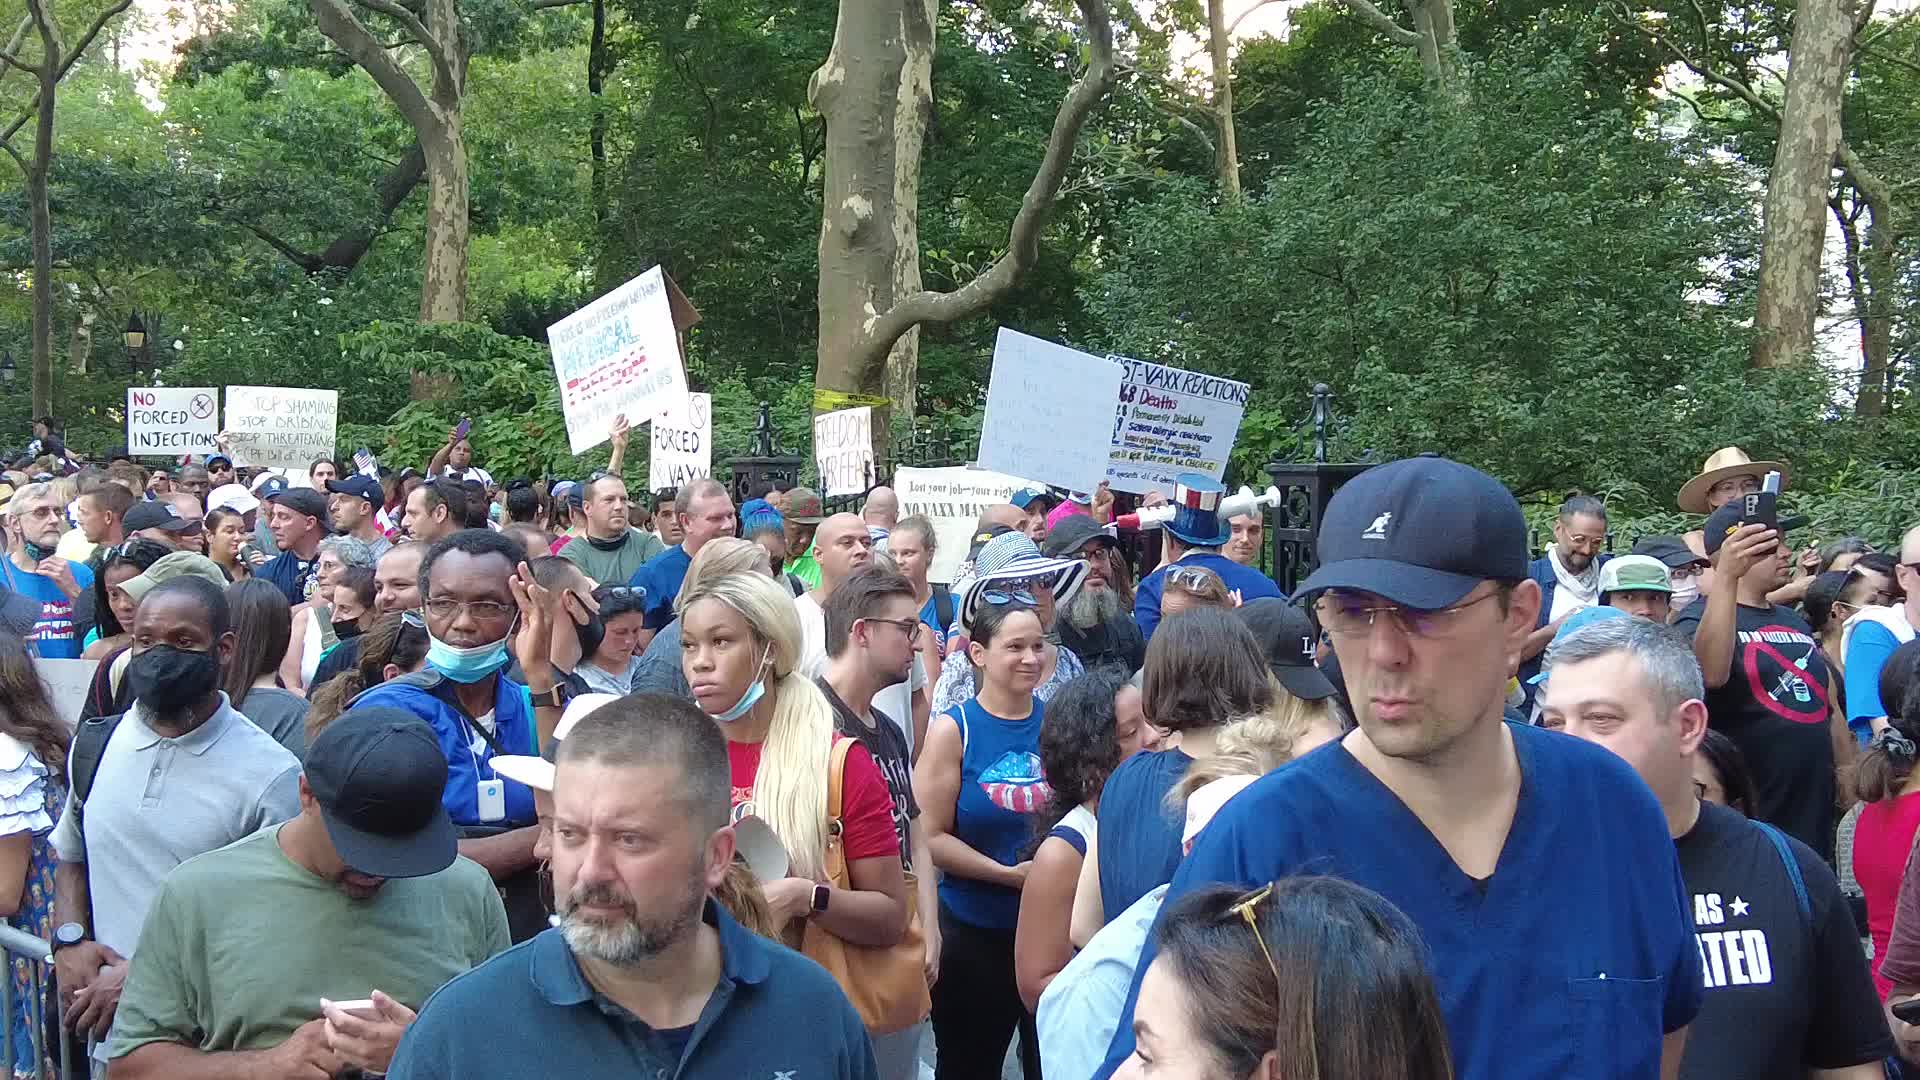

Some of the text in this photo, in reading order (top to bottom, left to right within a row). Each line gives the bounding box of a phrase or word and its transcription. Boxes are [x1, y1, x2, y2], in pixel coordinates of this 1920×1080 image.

[1108, 357, 1249, 403] ST-VAXX REACTIONS
[133, 391, 156, 406] NO
[287, 399, 336, 416] SHAMING
[133, 410, 188, 425] FORCED
[240, 415, 267, 428] STOP
[133, 431, 217, 447] INJECTIONS
[265, 432, 335, 447] THREATENING
[655, 425, 699, 454] FORCED
[816, 413, 870, 453] FREEDOM
[910, 481, 926, 492] Lost
[928, 482, 947, 494] your
[994, 486, 1013, 498] righ
[904, 503, 990, 518] NO VAXX MAN
[1694, 893, 1724, 925] AS
